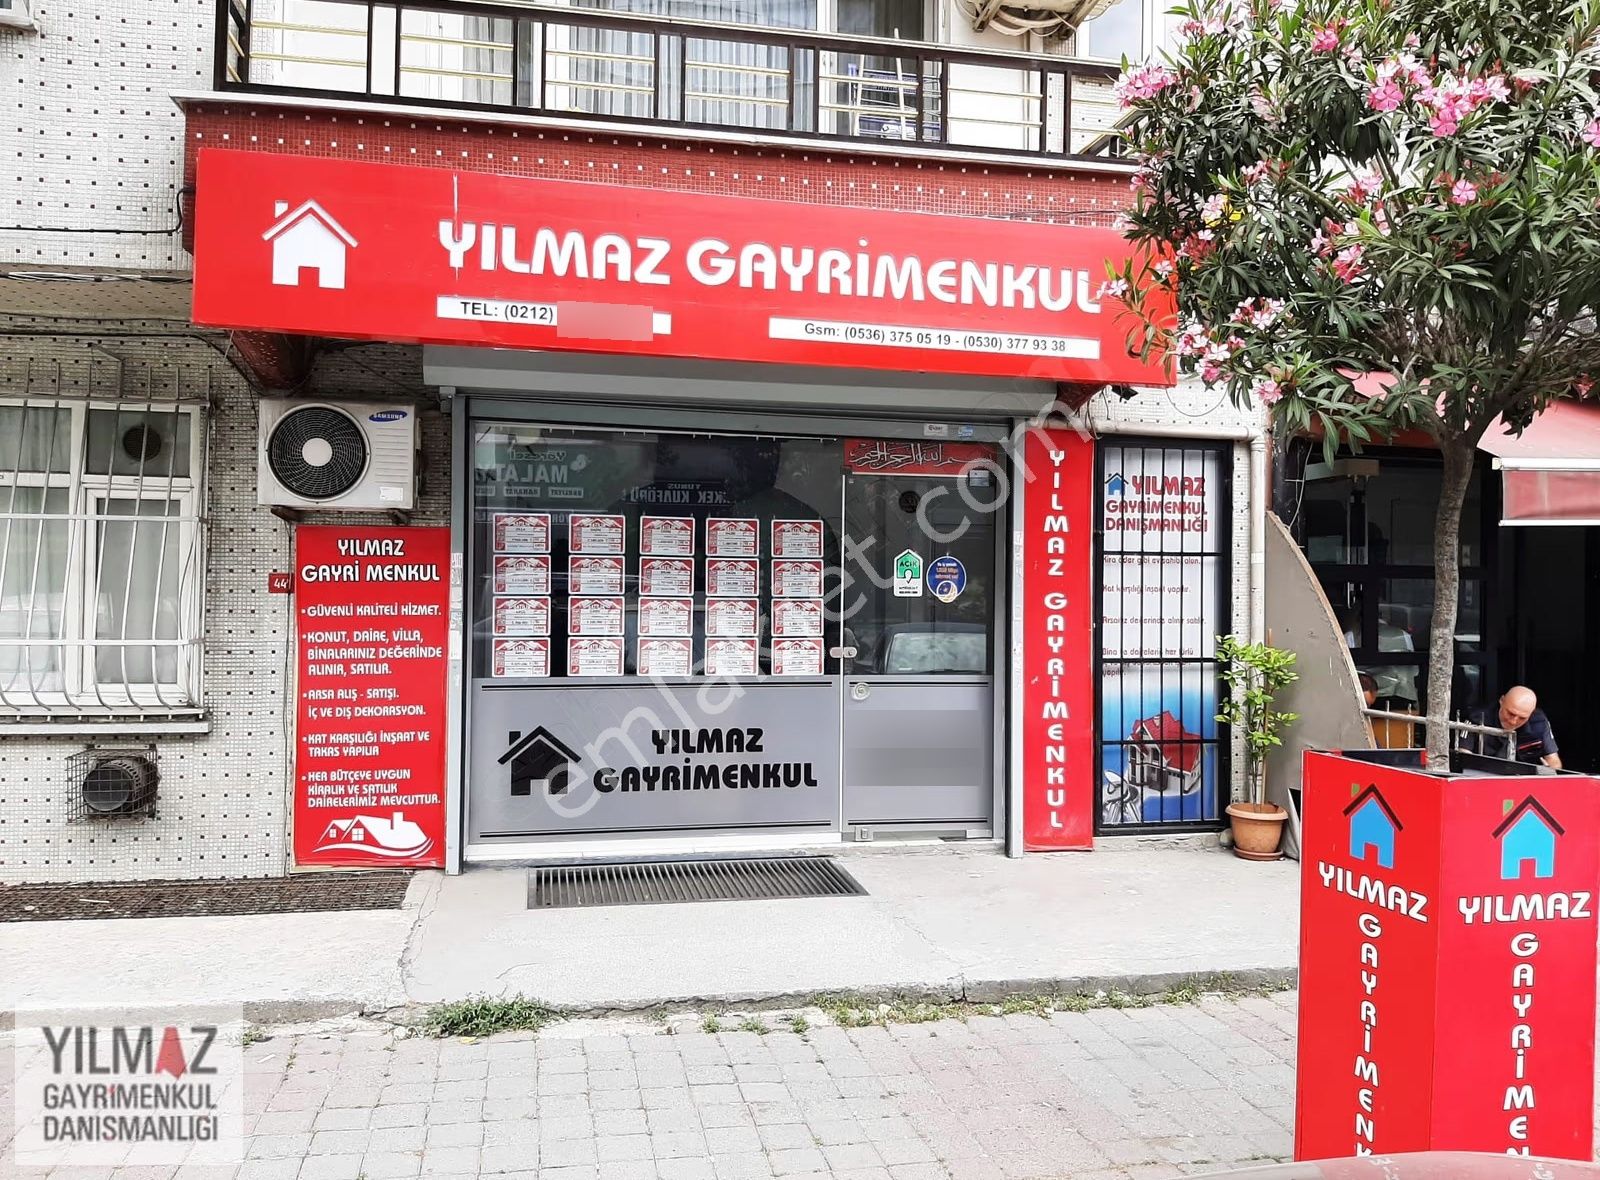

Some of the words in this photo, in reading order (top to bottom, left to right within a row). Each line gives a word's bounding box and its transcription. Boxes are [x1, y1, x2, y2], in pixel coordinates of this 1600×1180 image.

[439, 220, 671, 285] YILMAZ
[686, 237, 1101, 313] GAYRİMENKUL
[460, 301, 498, 318] TEL:
[504, 303, 554, 323] (0212)
[804, 322, 840, 337] Gsm:
[845, 325, 886, 343] (0536)
[889, 328, 912, 343] 375
[916, 330, 932, 345] 05
[936, 331, 951, 346] 19
[963, 334, 1002, 353] (0530)
[1006, 336, 1028, 350] 377
[1032, 339, 1047, 351] 93
[1051, 340, 1066, 352] 38
[1131, 475, 1206, 496] YILMAZ
[1044, 449, 1069, 577] YILMAZ
[1105, 497, 1208, 515] GAYRİMENKUL
[1105, 515, 1208, 536] DANIŞMANLIĞI
[338, 539, 404, 556] YILMAZ
[302, 560, 359, 582] GAYRİ
[366, 564, 440, 582] MENKUL
[307, 603, 353, 617] GÜVENLİ
[356, 602, 398, 616] KALİTELİ
[401, 602, 442, 616] HİZMET.
[307, 630, 350, 644] KONUT,
[353, 628, 390, 643] DAİRE,
[392, 628, 424, 643] VİLLA,
[308, 646, 376, 660] BİNALARINIZ
[379, 645, 442, 659] DEĞERİNDE
[308, 664, 347, 677] ALINIR,
[350, 663, 392, 676] SATILIR.
[308, 689, 335, 700] ARSA
[337, 689, 358, 702] ALIŞ
[366, 687, 400, 701] SATIŞI.
[308, 705, 318, 720] İÇ
[320, 707, 332, 717] VE
[335, 706, 352, 719] DIŞ
[354, 705, 426, 718] DEKORASYON.
[1043, 592, 1069, 828] GAYRİMENKUL
[308, 733, 327, 744] KAT
[330, 731, 378, 745] KARŞILIĞI
[380, 730, 416, 744] İNŞAAT
[417, 731, 430, 741] VE
[651, 728, 763, 755] YILMAZ
[308, 747, 340, 758] TAKAS
[342, 746, 380, 757] YAPILIR
[308, 771, 328, 782] HER
[330, 769, 372, 783] BÜTÇEYE
[374, 769, 411, 780] UYGUN
[593, 757, 817, 793] GAYRİMENKUL
[308, 783, 345, 796] KİRALIK
[347, 784, 360, 796] VE
[362, 783, 398, 795] SATILIK
[308, 795, 378, 809] DAİRELERİMİZ
[380, 794, 441, 807] MEVCUTTUR.
[1318, 861, 1429, 923] YILMAZ
[1458, 891, 1592, 924] YILMAZ
